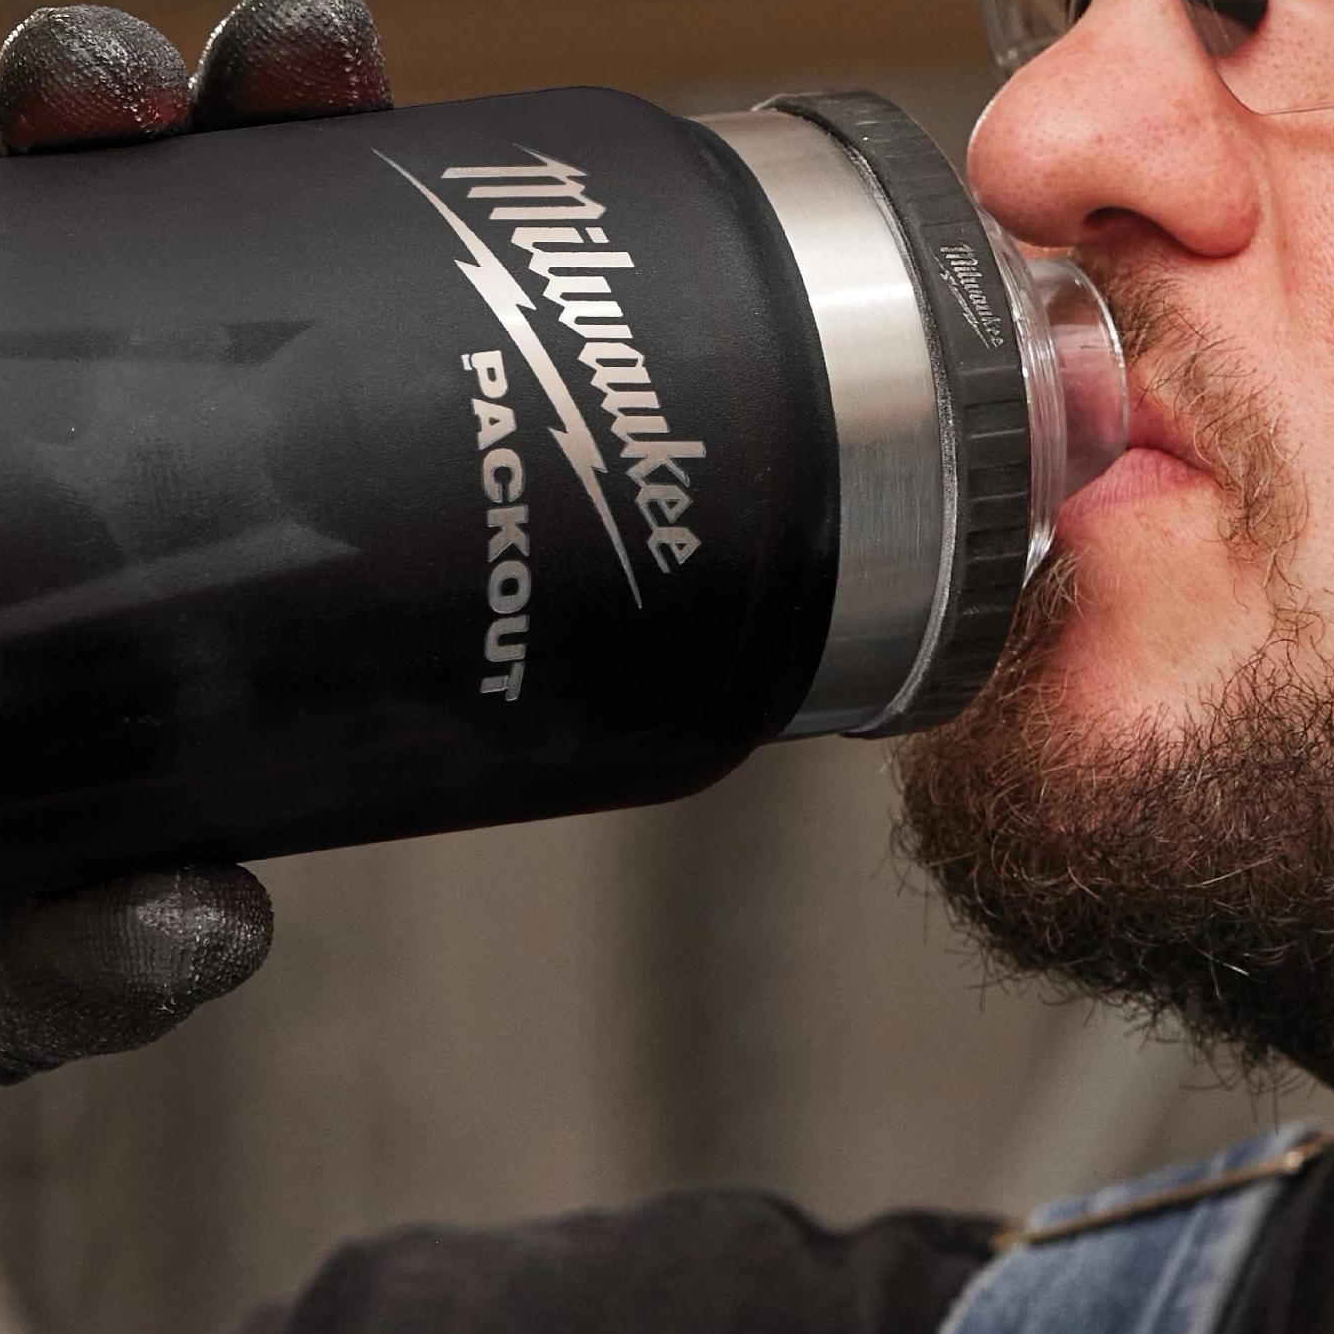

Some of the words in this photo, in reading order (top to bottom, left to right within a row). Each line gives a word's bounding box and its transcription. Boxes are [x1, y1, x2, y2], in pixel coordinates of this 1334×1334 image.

[440, 142, 707, 574] Milwaukee
[939, 240, 1005, 348] Milwaukee
[461, 349, 533, 703] PACKOUT
